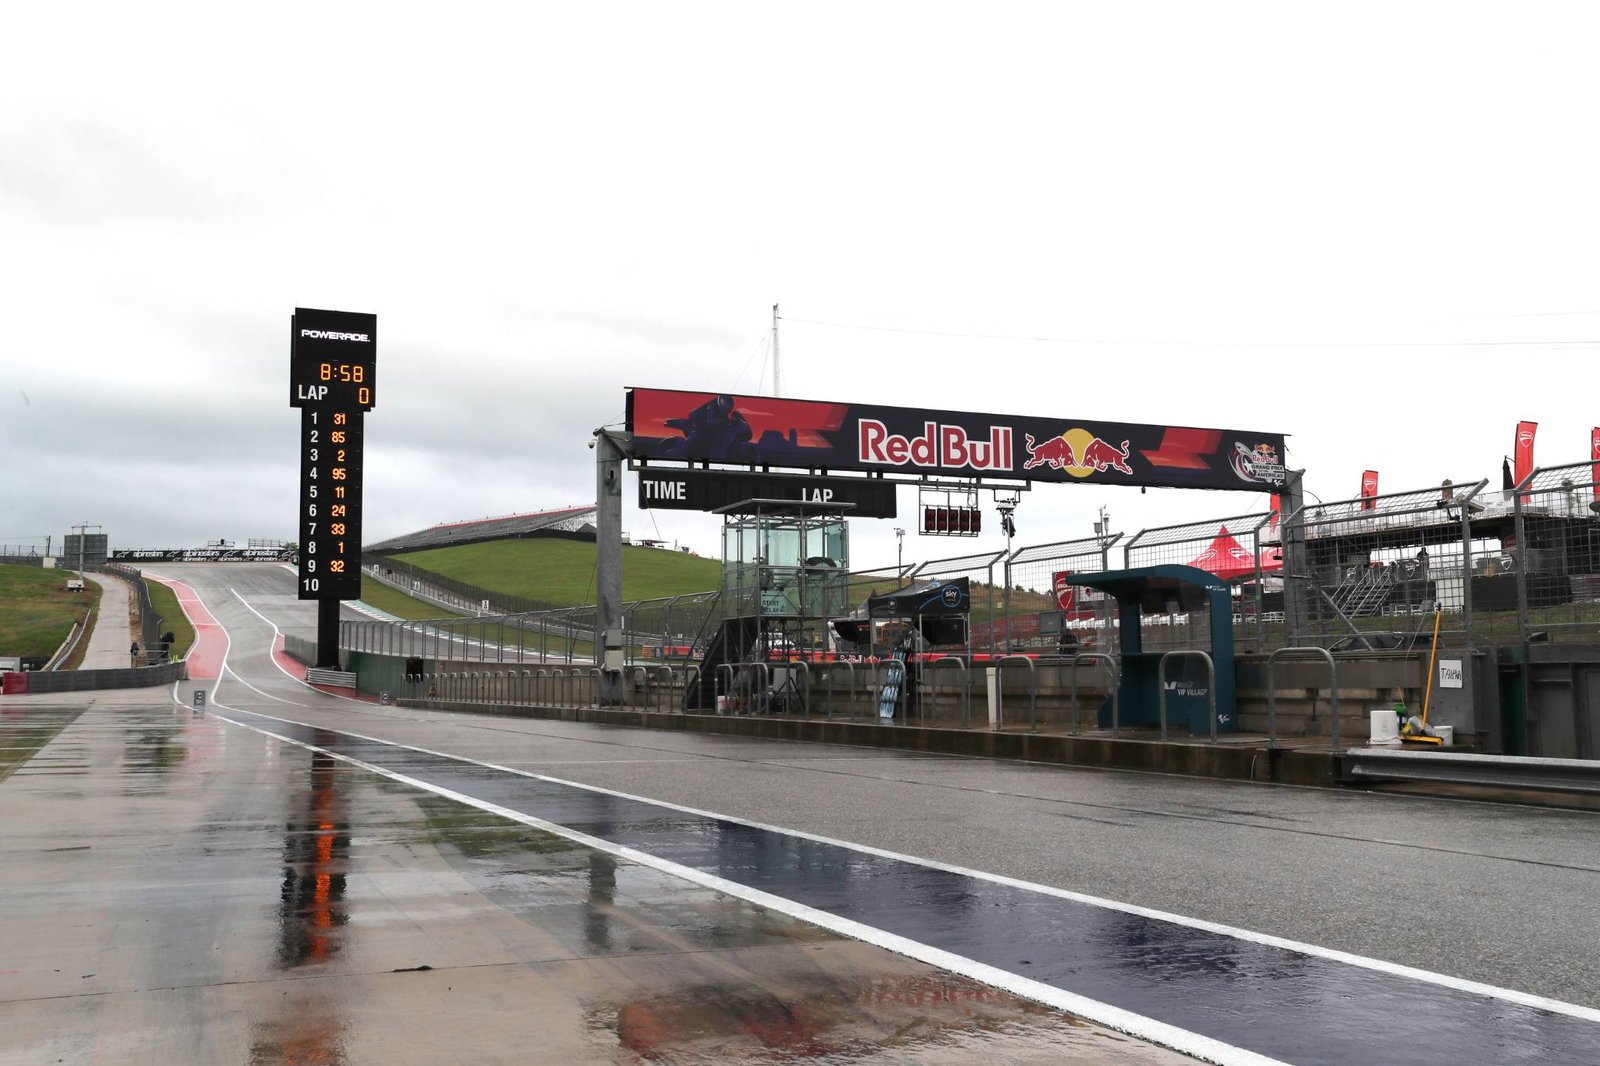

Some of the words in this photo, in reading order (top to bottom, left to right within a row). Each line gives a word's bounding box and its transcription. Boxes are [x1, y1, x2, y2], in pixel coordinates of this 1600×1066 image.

[302, 329, 370, 342] POWERADE
[321, 363, 363, 383] 8:58
[298, 384, 328, 401] LAP
[359, 387, 369, 404] 0
[311, 412, 318, 425] 1
[333, 413, 346, 425] 31
[310, 430, 318, 443] 2
[331, 431, 346, 444] 85
[859, 418, 937, 466] Red
[940, 425, 1013, 471] Bull
[310, 449, 318, 461] 3
[337, 450, 345, 462] 2
[310, 467, 318, 480] 4
[332, 468, 346, 480] 95
[309, 485, 318, 498] 5
[335, 486, 345, 499] 11
[643, 480, 687, 500] TIME
[309, 504, 317, 517] 6
[331, 505, 346, 517] 24
[309, 522, 317, 535] 7
[331, 523, 346, 535] 33
[308, 541, 316, 554] 8
[338, 542, 344, 554] 1
[308, 560, 316, 573] 9
[330, 560, 344, 572] 32
[303, 578, 319, 592] 10
